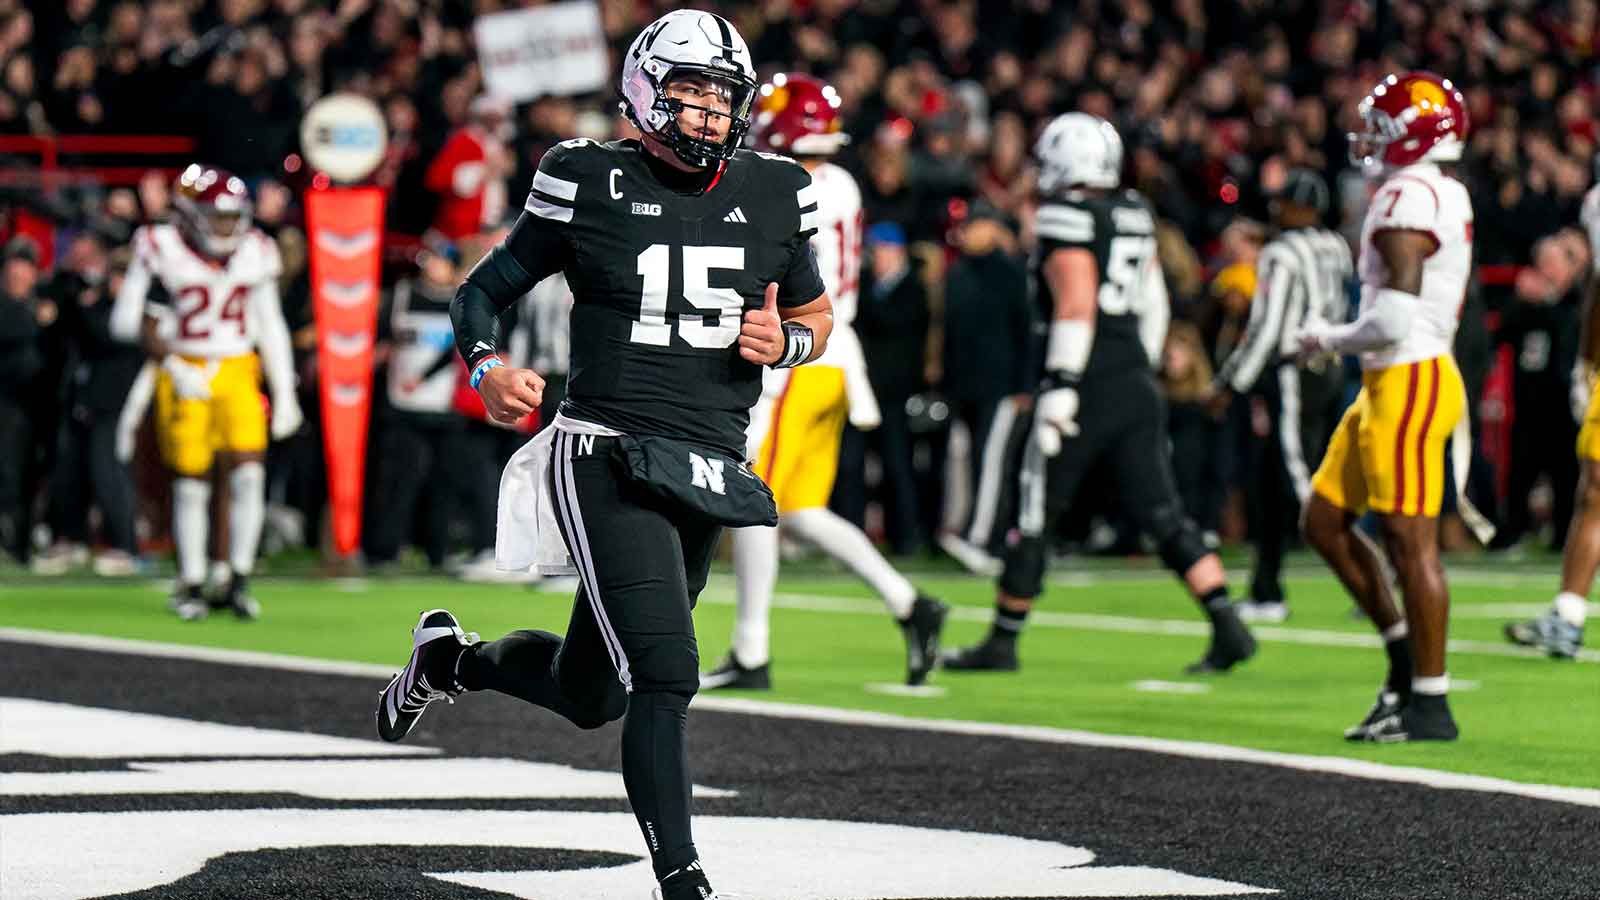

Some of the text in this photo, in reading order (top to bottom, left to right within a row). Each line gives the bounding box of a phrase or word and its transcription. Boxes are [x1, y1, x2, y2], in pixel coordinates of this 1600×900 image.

[609, 168, 623, 199] C
[1384, 189, 1402, 218] 7
[178, 285, 250, 339] 24
[630, 243, 744, 348] 15
[577, 434, 595, 456] N
[689, 452, 726, 495] N
